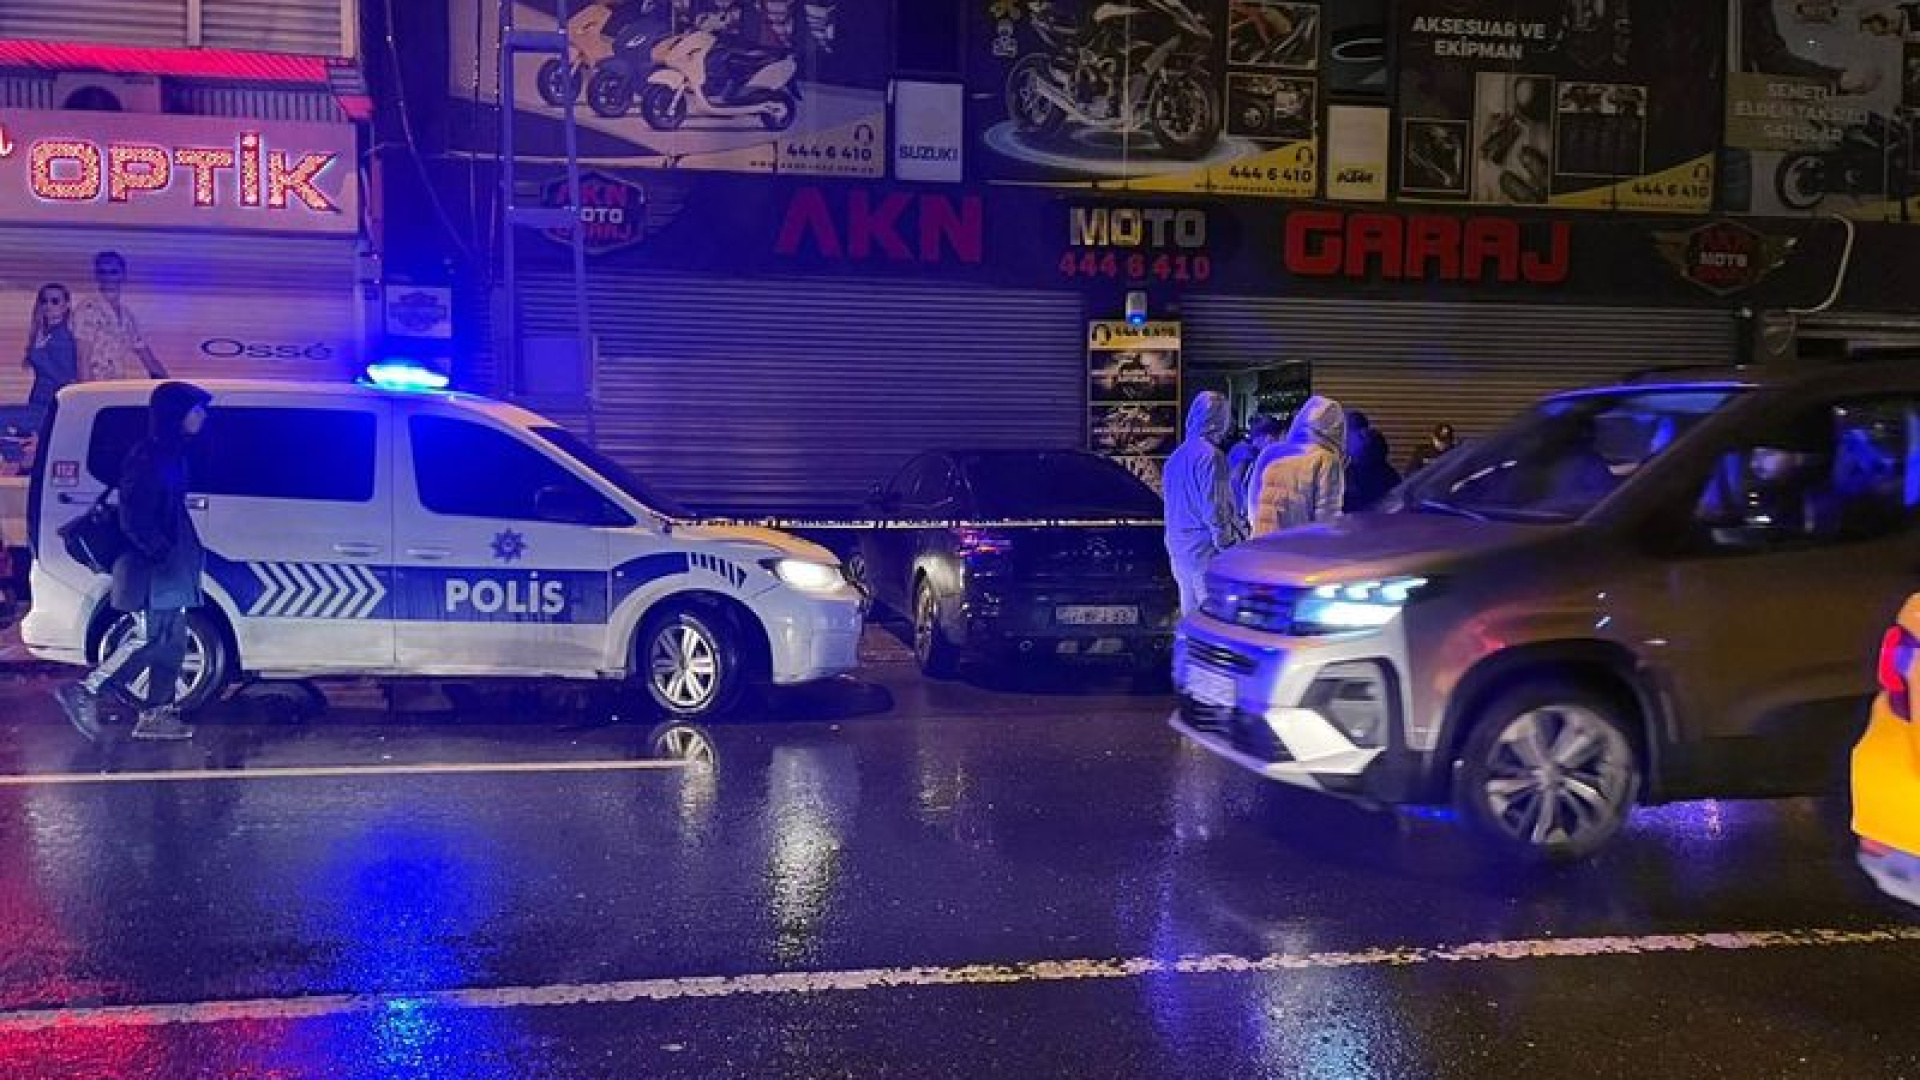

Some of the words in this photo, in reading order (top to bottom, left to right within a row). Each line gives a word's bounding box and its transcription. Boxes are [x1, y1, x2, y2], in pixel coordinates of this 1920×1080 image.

[1411, 17, 1518, 37] AKSESUAR
[1521, 22, 1547, 39] VE
[1434, 36, 1525, 60] EKİPMAN
[787, 144, 821, 158] 444
[826, 146, 836, 159] 6
[842, 146, 872, 161] 410
[899, 145, 958, 161] SUZUKI
[31, 131, 341, 213] OPTİK
[1229, 166, 1263, 180] 444
[1267, 168, 1278, 181] 6
[1283, 168, 1312, 183] 410
[1632, 183, 1663, 195] 444
[1682, 185, 1710, 199] 410
[774, 187, 983, 263] AKN
[1070, 208, 1206, 246] MOTO
[1285, 211, 1570, 282] GARAJ
[1058, 252, 1117, 277] 444
[1127, 254, 1145, 278] 6
[1151, 254, 1211, 281] 410
[201, 338, 333, 360] Ossé
[446, 571, 565, 614] POLİS
